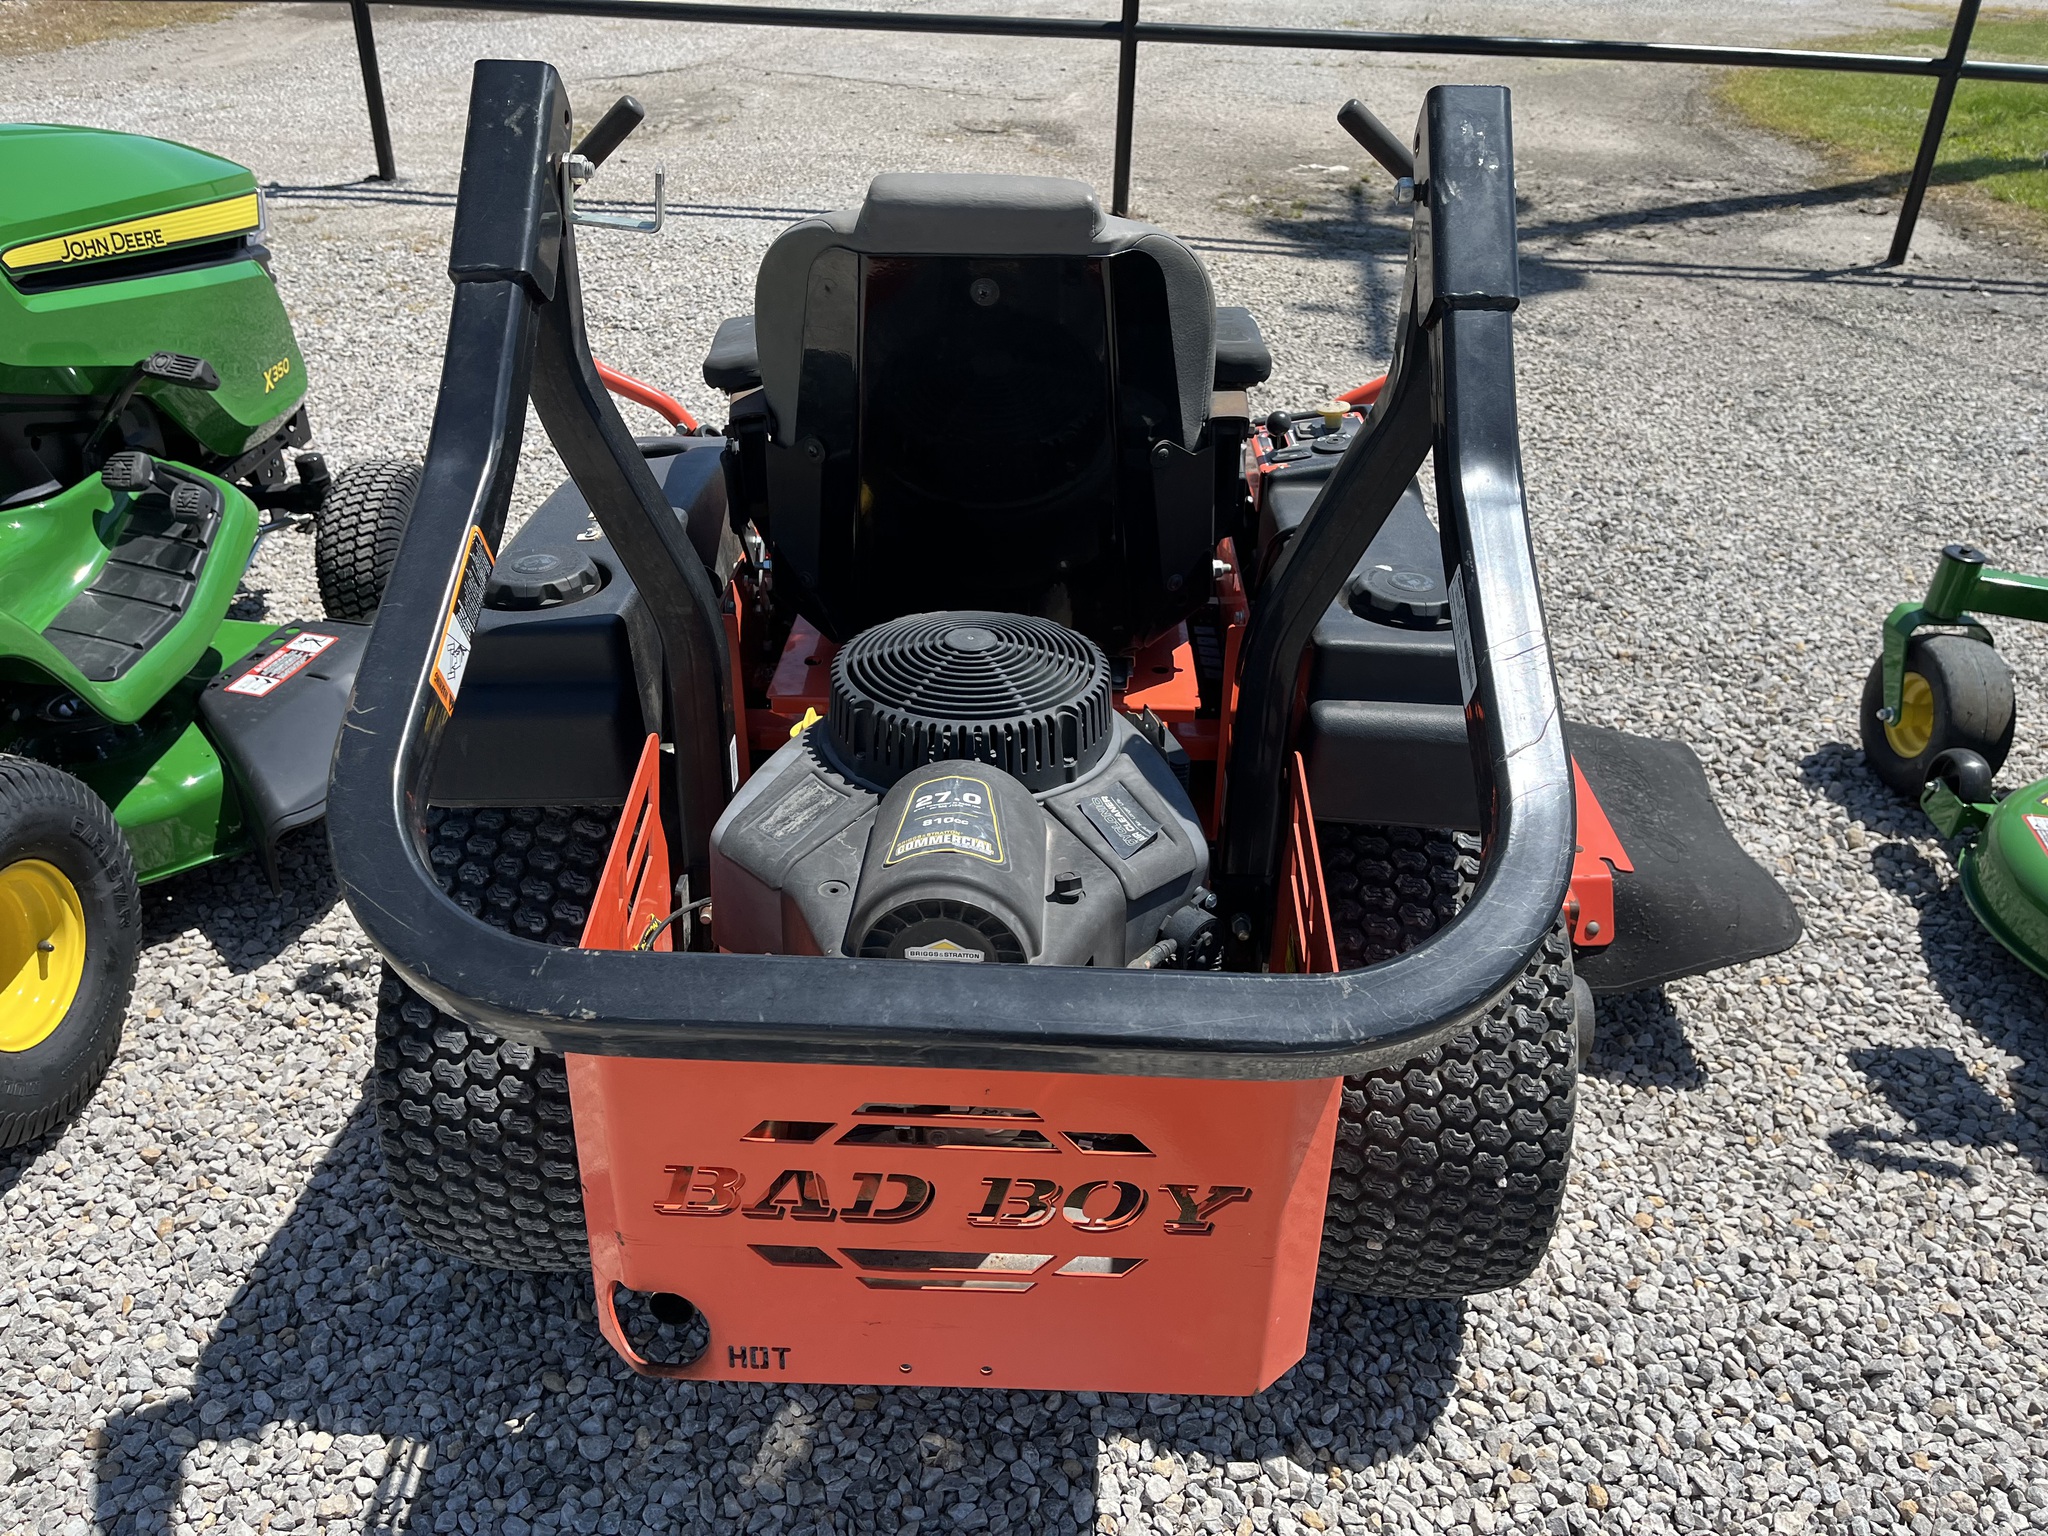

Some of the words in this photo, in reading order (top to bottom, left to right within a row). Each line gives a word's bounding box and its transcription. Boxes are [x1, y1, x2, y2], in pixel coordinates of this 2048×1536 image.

[61, 236, 110, 260] JOHN
[109, 228, 166, 251] DEERE
[263, 357, 290, 394] X350
[915, 790, 982, 809] 27.0
[1100, 795, 1136, 832] CLEANER
[922, 816, 969, 827] 810cc
[1091, 796, 1138, 847] CYCLONIC
[895, 834, 995, 857] COMMERCIAL
[1131, 831, 1148, 842] AIR
[652, 1164, 936, 1225] BAD
[966, 1176, 1253, 1236] BOY
[727, 1344, 792, 1370] HOT
